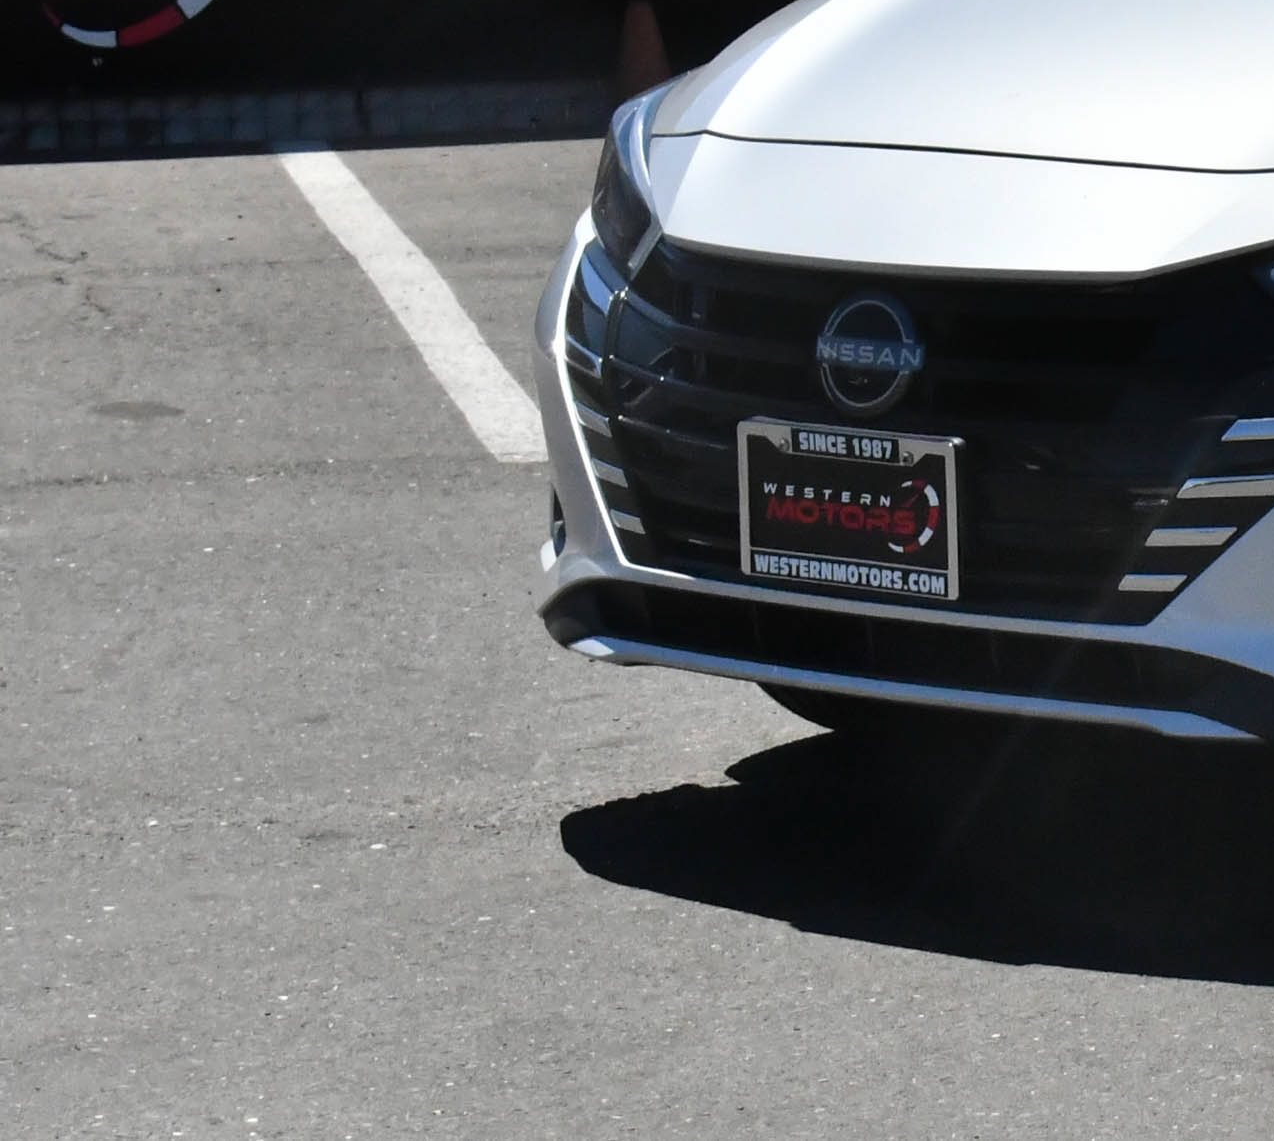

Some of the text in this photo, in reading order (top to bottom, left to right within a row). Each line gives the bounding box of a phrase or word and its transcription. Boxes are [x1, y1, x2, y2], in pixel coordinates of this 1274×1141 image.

[816, 340, 921, 366] NISSAN
[798, 431, 893, 459] SINCE 1987
[763, 482, 891, 507] WESTERN
[767, 498, 916, 535] MOTORS
[754, 554, 945, 594] WESTERNMOTORS.COM
